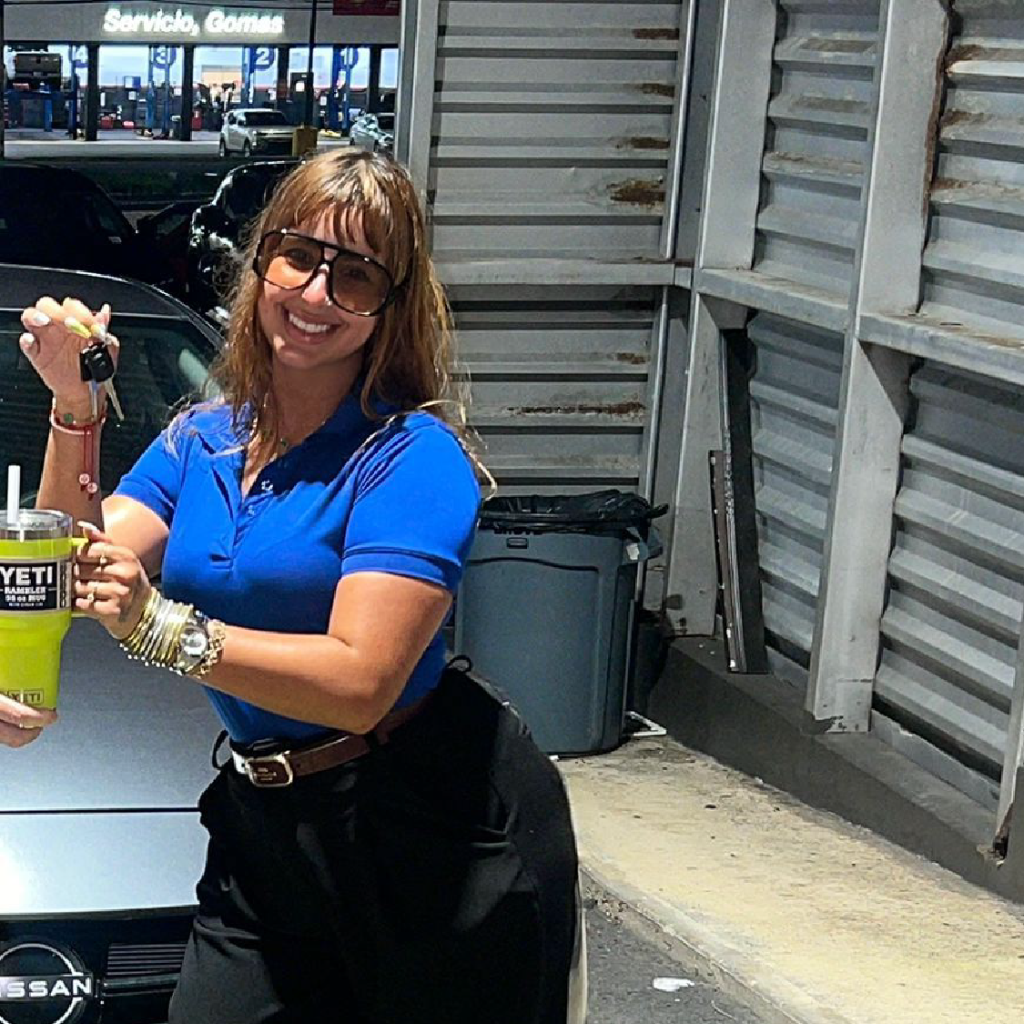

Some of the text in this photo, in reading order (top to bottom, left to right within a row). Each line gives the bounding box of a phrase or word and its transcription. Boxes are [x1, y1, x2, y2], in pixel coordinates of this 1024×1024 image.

[103, 8, 284, 36] Servicio, Gomas
[255, 47, 270, 66] 2
